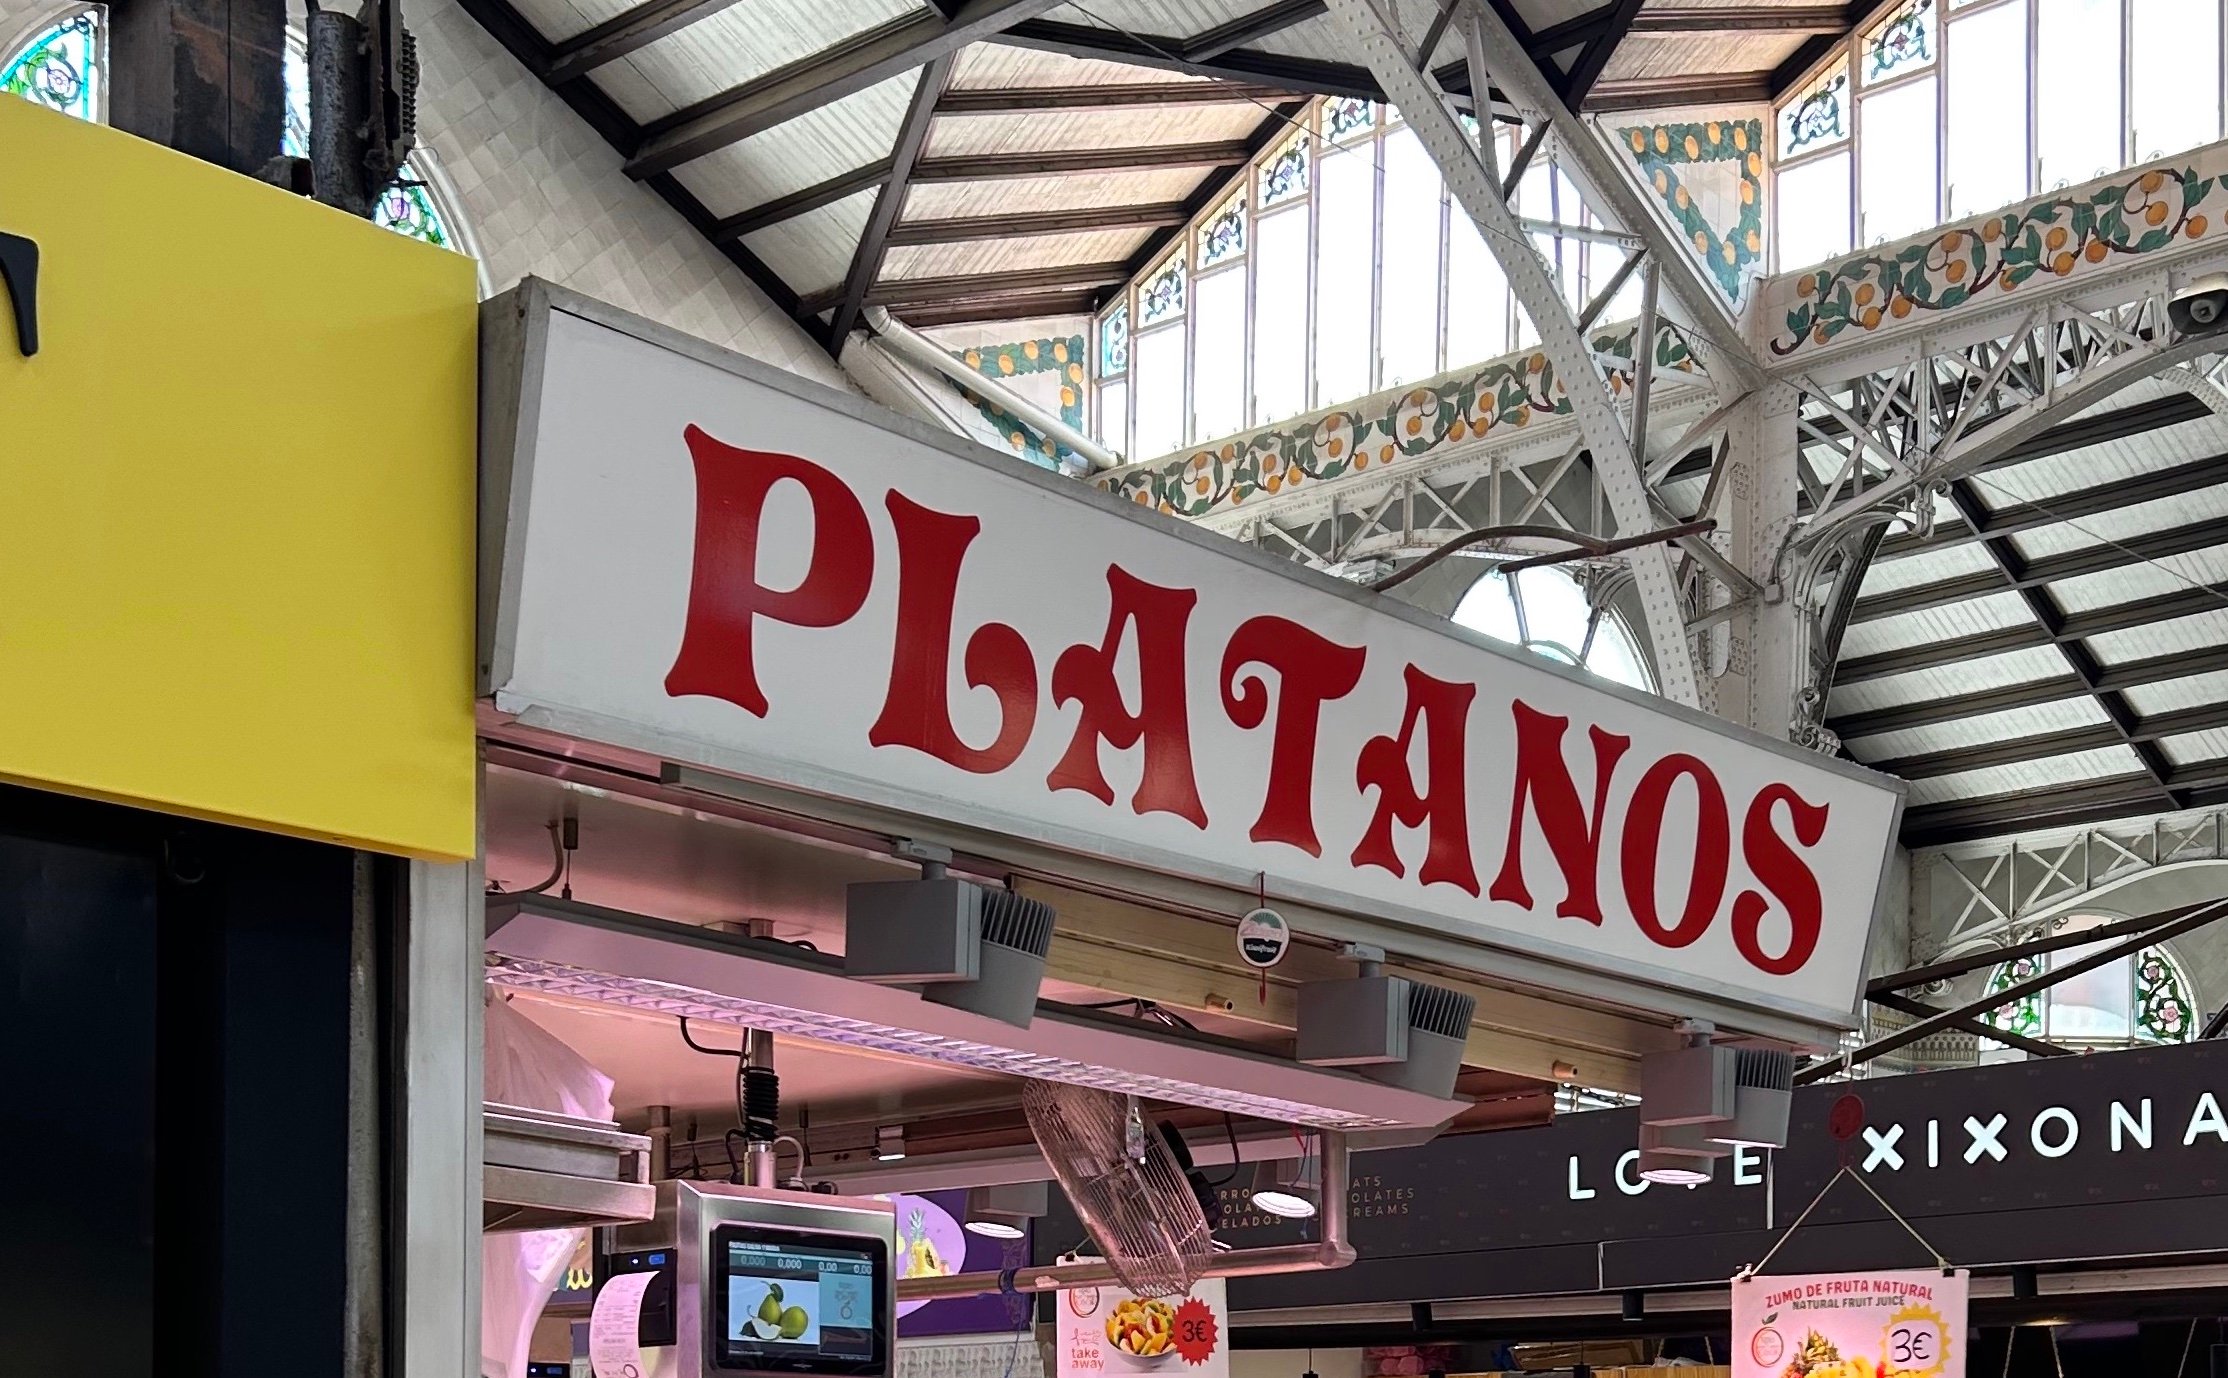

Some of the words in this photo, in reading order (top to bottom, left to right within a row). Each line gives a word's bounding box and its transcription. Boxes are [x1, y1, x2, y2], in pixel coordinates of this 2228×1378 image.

[666, 427, 1827, 974] PLATANOS
[1569, 1144, 1762, 1200] LOE
[1862, 1092, 2228, 1173] XIXONA
[1353, 1203, 1409, 1218] REAMS
[1222, 1215, 1282, 1229] ELADOS
[1765, 1288, 1802, 1309] ZUMO
[1807, 1282, 1822, 1297] DE
[1826, 1280, 1868, 1295] FRUTA
[1872, 1281, 1933, 1301] NATURAL
[1792, 1299, 1840, 1311] NATURAL
[1842, 1297, 1873, 1308] FRUIT
[1875, 1296, 1905, 1306] JUICE
[1182, 1320, 1208, 1343] 3€
[1072, 1348, 1099, 1359] take
[1891, 1328, 1933, 1363] 3€
[1071, 1359, 1105, 1371] away
